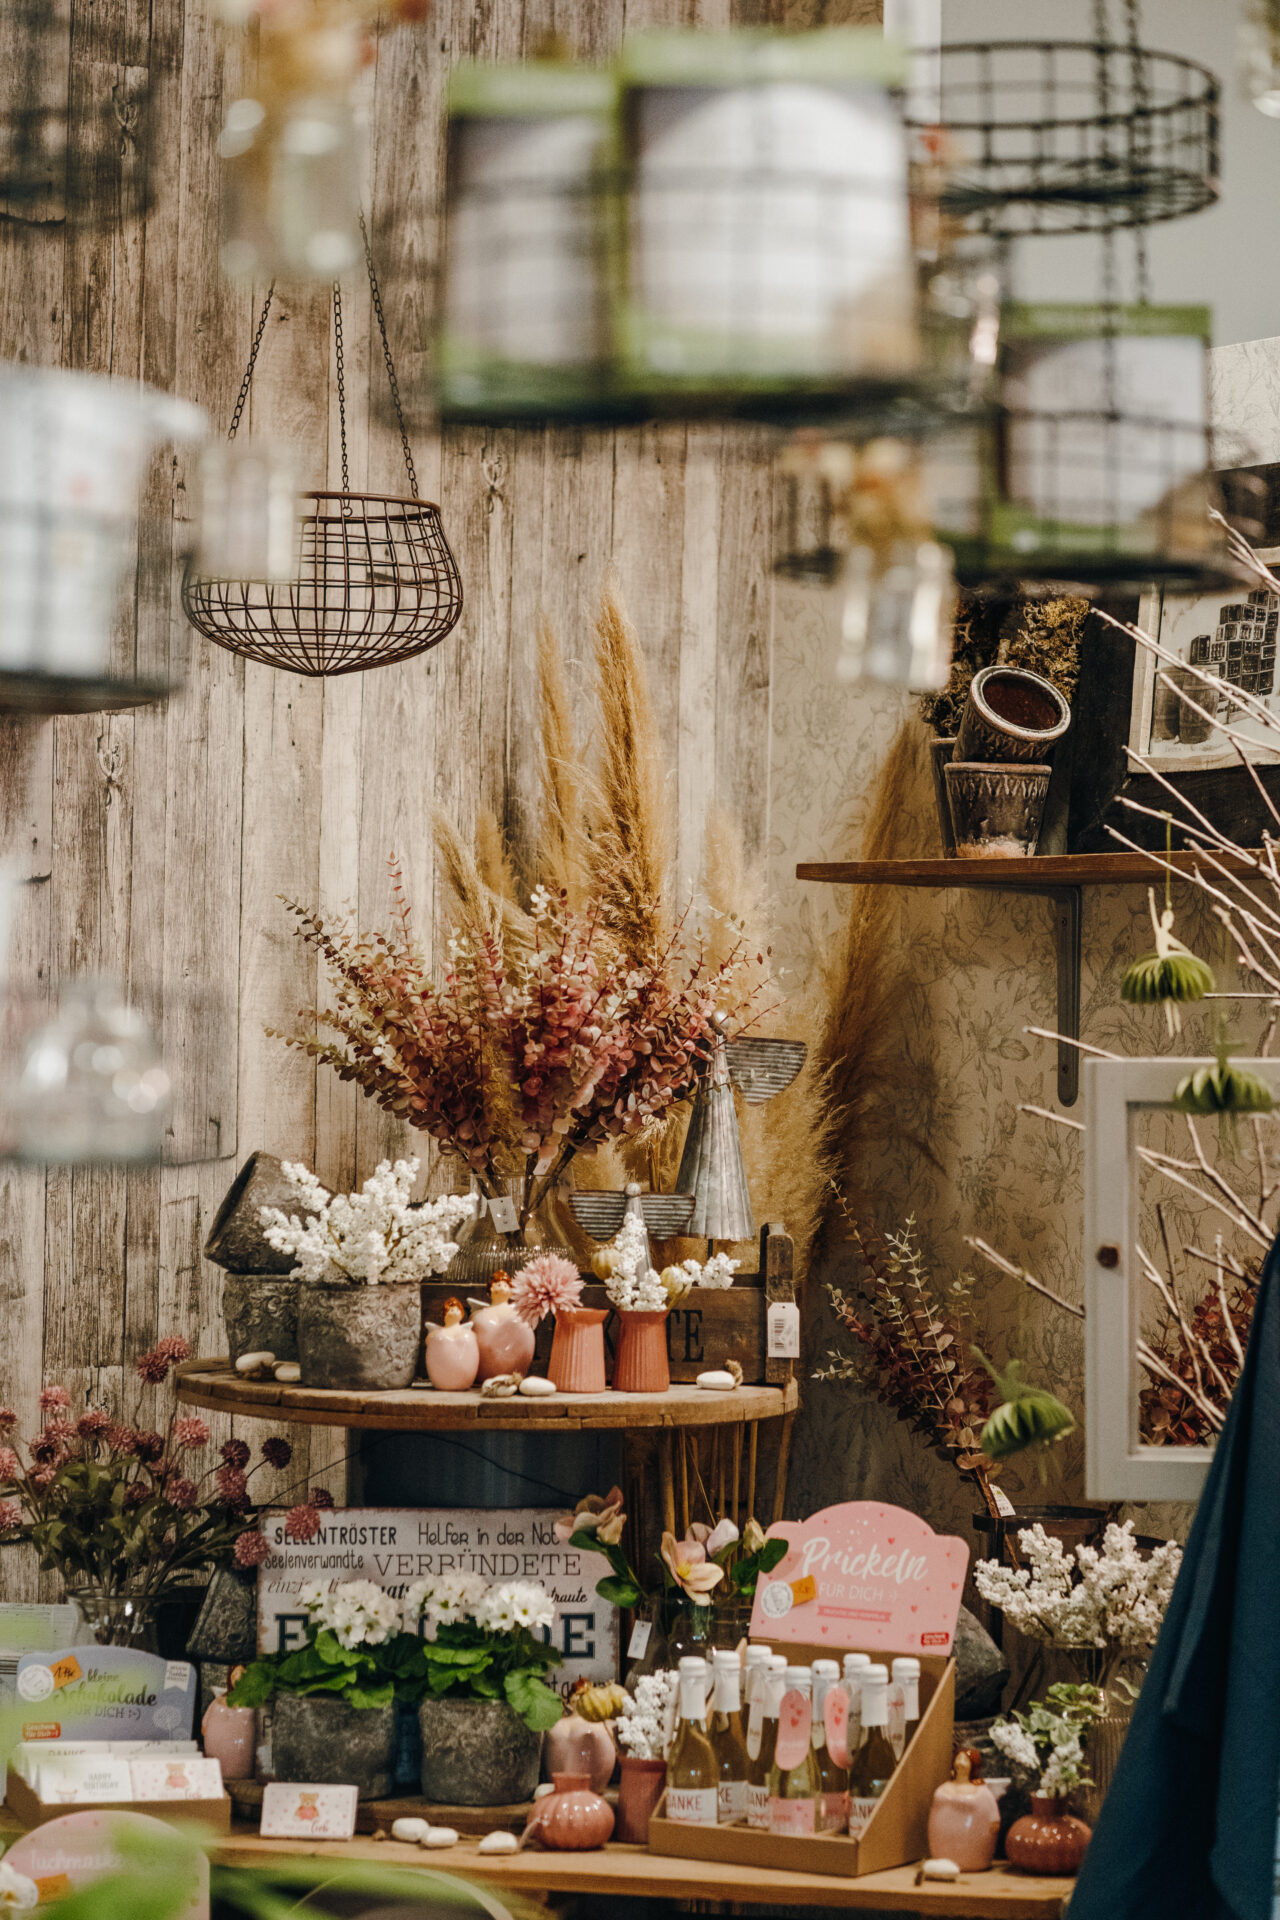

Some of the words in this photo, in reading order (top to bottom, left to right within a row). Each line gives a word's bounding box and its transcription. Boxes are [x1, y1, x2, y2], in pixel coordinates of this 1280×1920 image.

[274, 1523, 397, 1546] SENTRÖSTER
[418, 1521, 469, 1546] Helfer
[477, 1527, 489, 1546] in
[496, 1521, 525, 1546] der
[532, 1521, 560, 1546] Not
[265, 1549, 364, 1570] Seelenverwandte
[373, 1548, 582, 1577] VERBÜNDETE
[803, 1537, 929, 1584] Prickeln
[848, 1584, 884, 1602] DICH
